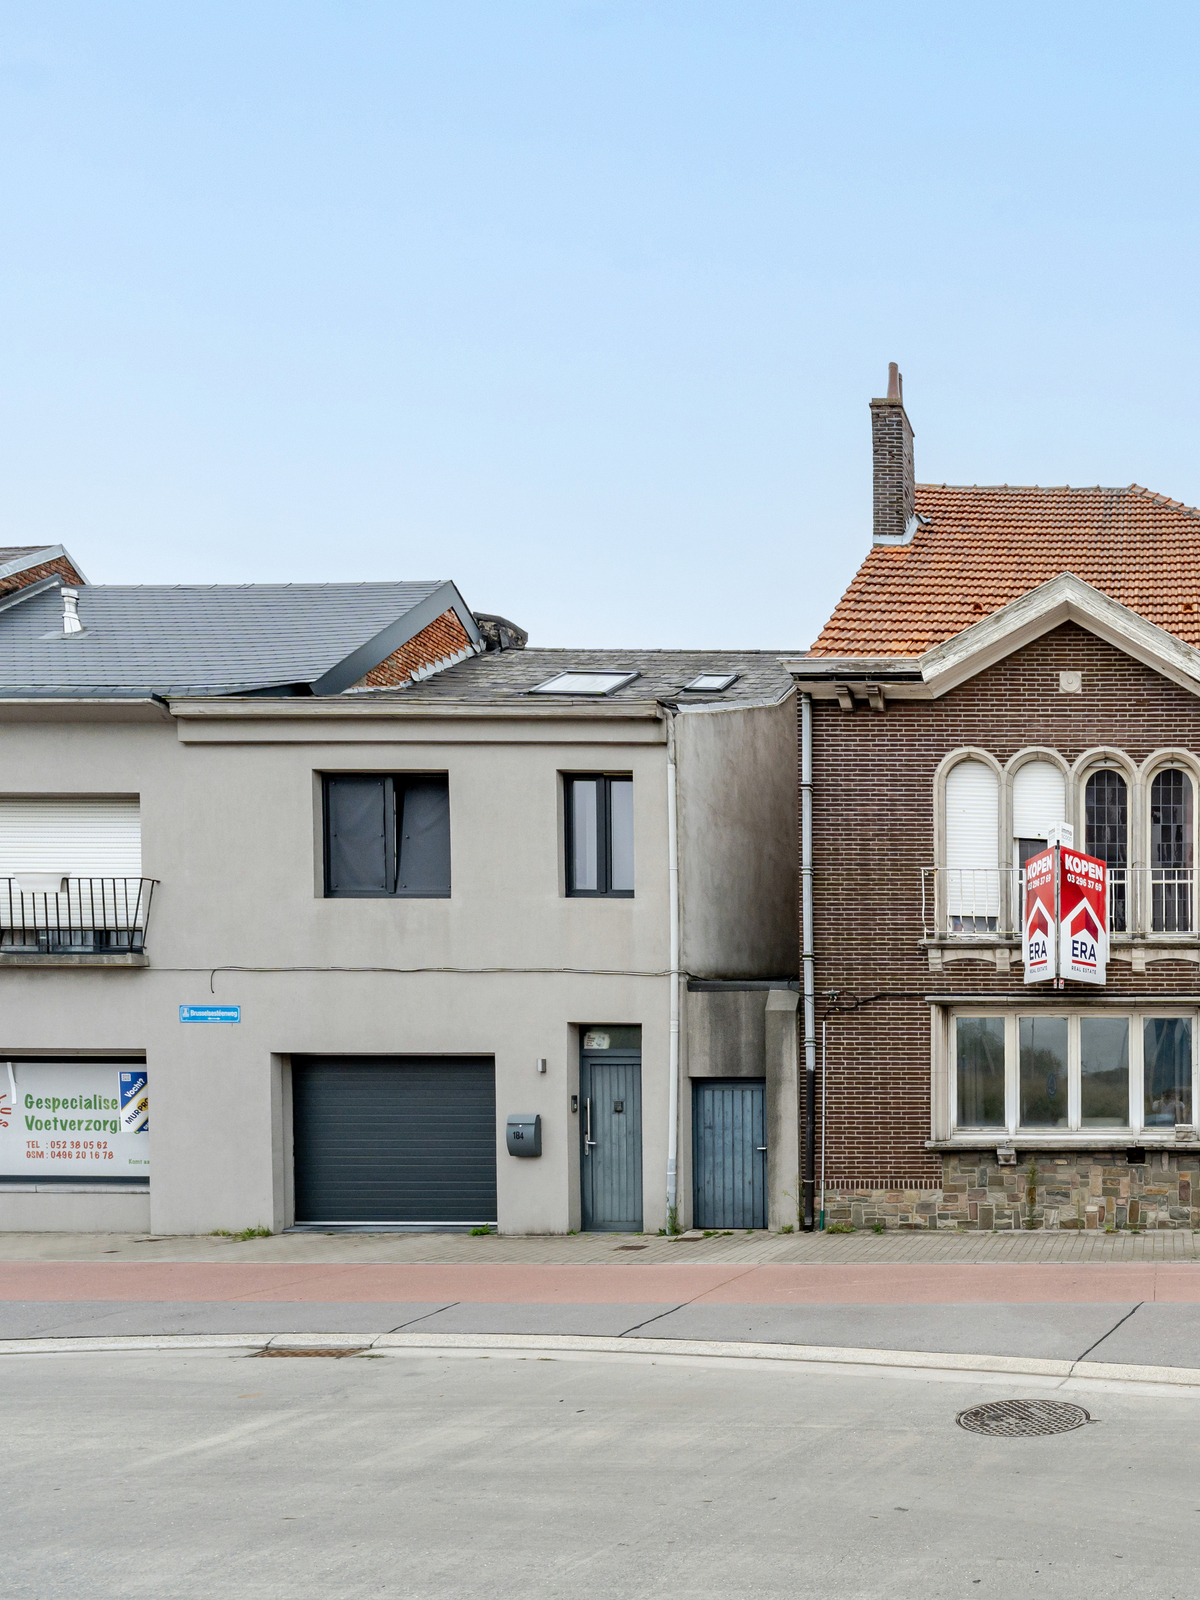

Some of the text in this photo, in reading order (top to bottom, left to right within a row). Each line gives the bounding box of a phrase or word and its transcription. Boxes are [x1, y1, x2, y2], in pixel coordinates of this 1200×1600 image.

[1027, 854, 1053, 880] KOPEN
[1065, 854, 1104, 881] KOPEN
[1067, 873, 1103, 892] 03 296 37 69
[1029, 940, 1047, 960] ERA
[1072, 939, 1097, 961] ERA
[1082, 967, 1097, 975] ESTATE
[124, 1077, 145, 1098] Vocht?
[24, 1093, 119, 1113] Gespecialise
[24, 1115, 141, 1134] Voetverzorgi
[26, 1140, 41, 1149] TEL
[50, 1140, 67, 1149] 052
[70, 1140, 81, 1149] 38
[83, 1140, 94, 1150] 05
[96, 1140, 108, 1150] 62
[512, 1131, 524, 1140] 184
[50, 1150, 73, 1159] 0496
[75, 1150, 87, 1159] 20
[90, 1150, 100, 1159] 16
[103, 1150, 114, 1160] 78
